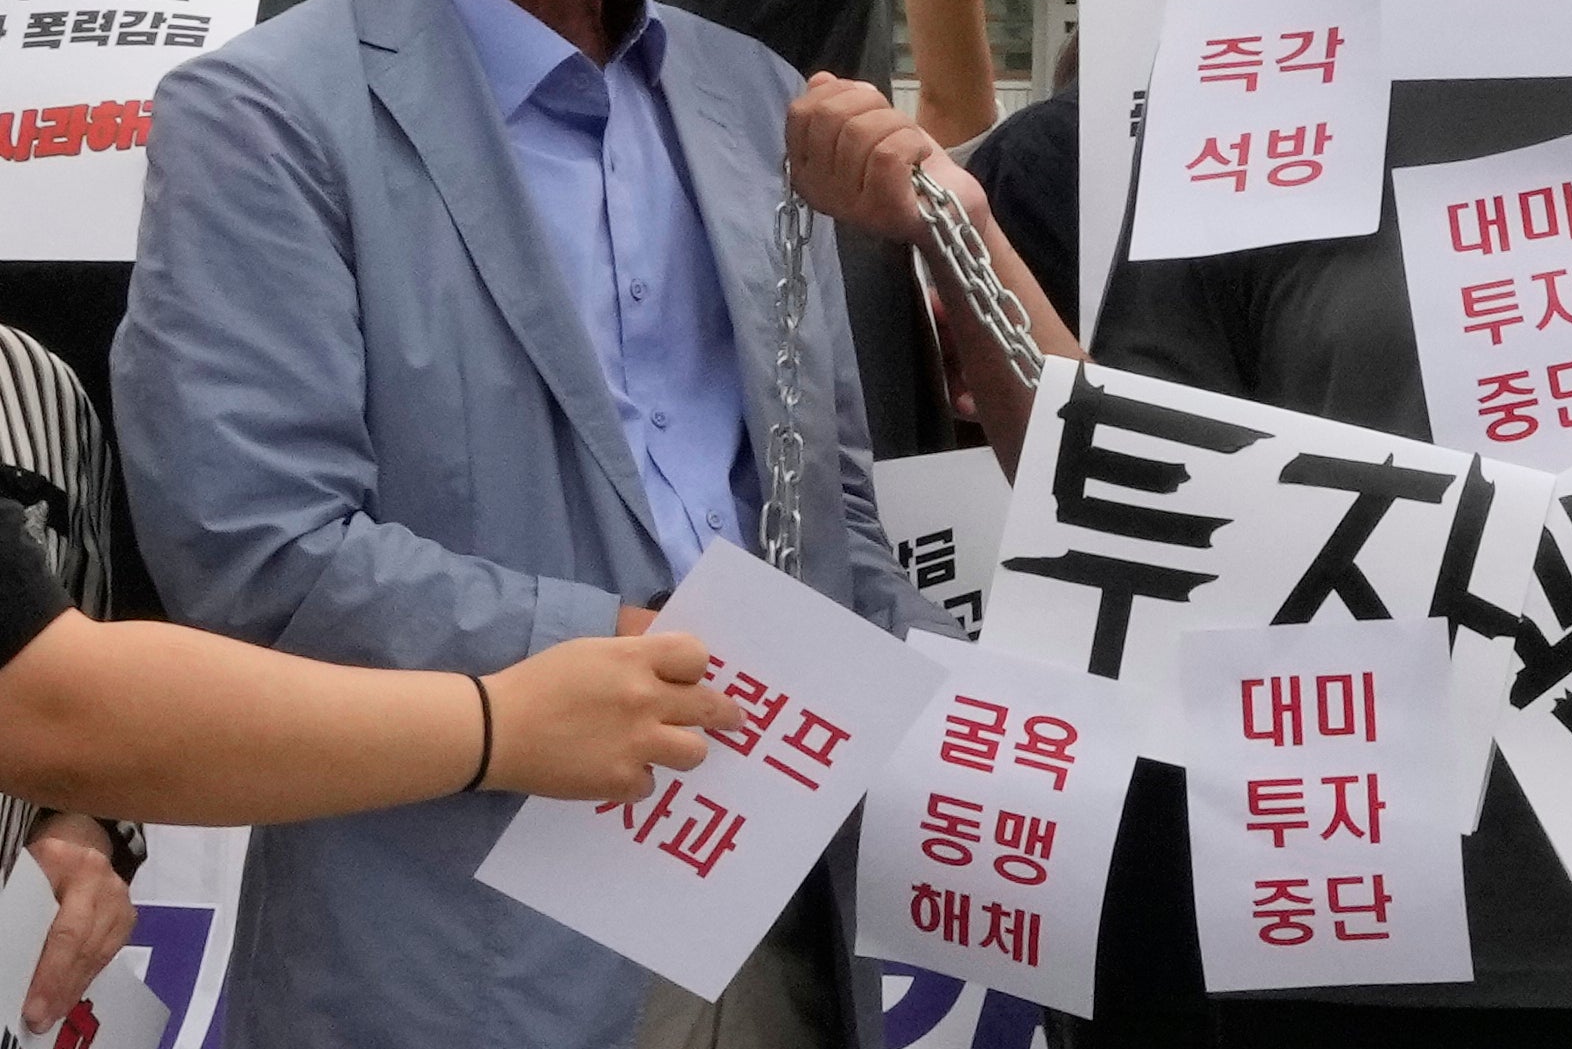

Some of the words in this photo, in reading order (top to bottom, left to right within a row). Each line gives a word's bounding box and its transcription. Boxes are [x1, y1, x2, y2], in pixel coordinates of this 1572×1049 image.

[22, 9, 212, 49] 폭력감금
[1197, 26, 1345, 93] 즉각
[0, 99, 154, 162] 사과하
[1185, 121, 1334, 193] 석방
[940, 694, 1079, 792] 굴욕
[1240, 671, 1378, 747] 대미
[920, 792, 1057, 886] 동맹
[1246, 772, 1387, 849] 투자
[910, 881, 1042, 968] 해체
[1252, 873, 1394, 947] 중단
